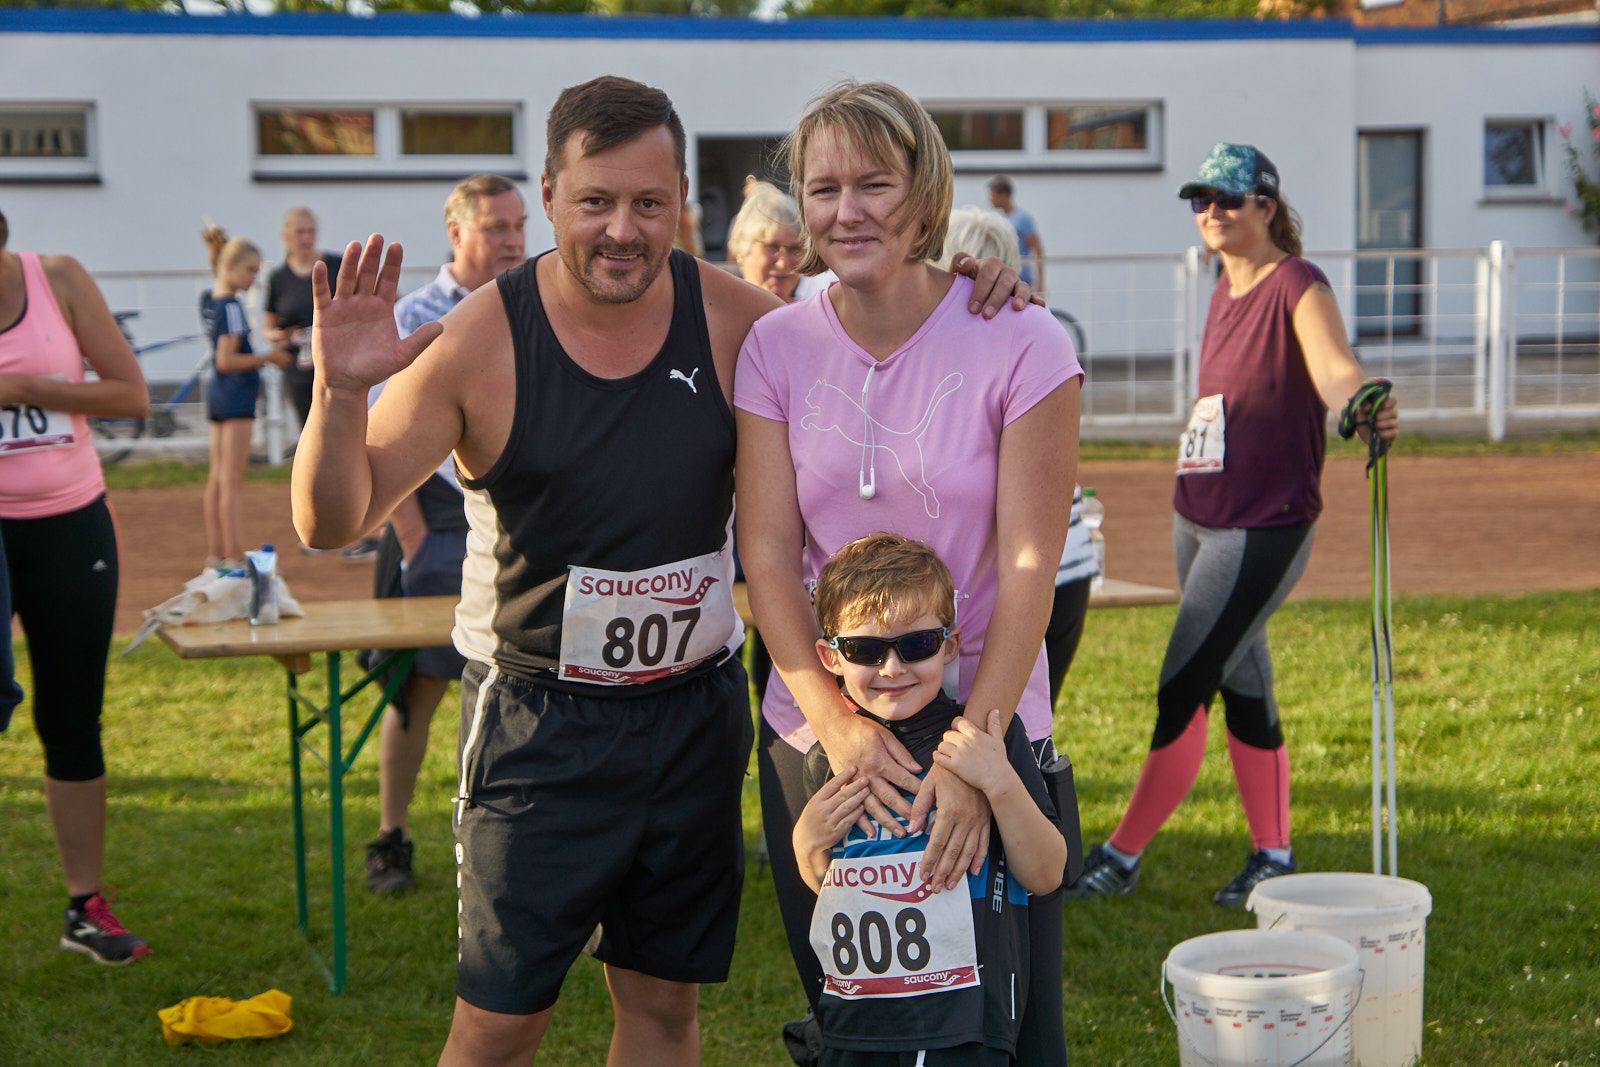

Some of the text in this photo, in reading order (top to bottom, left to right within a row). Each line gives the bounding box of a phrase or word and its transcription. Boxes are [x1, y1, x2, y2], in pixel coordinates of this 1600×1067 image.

[601, 606, 701, 669] 807
[578, 666, 620, 678] saucony
[831, 907, 931, 976] 808
[903, 971, 948, 985] saucony
